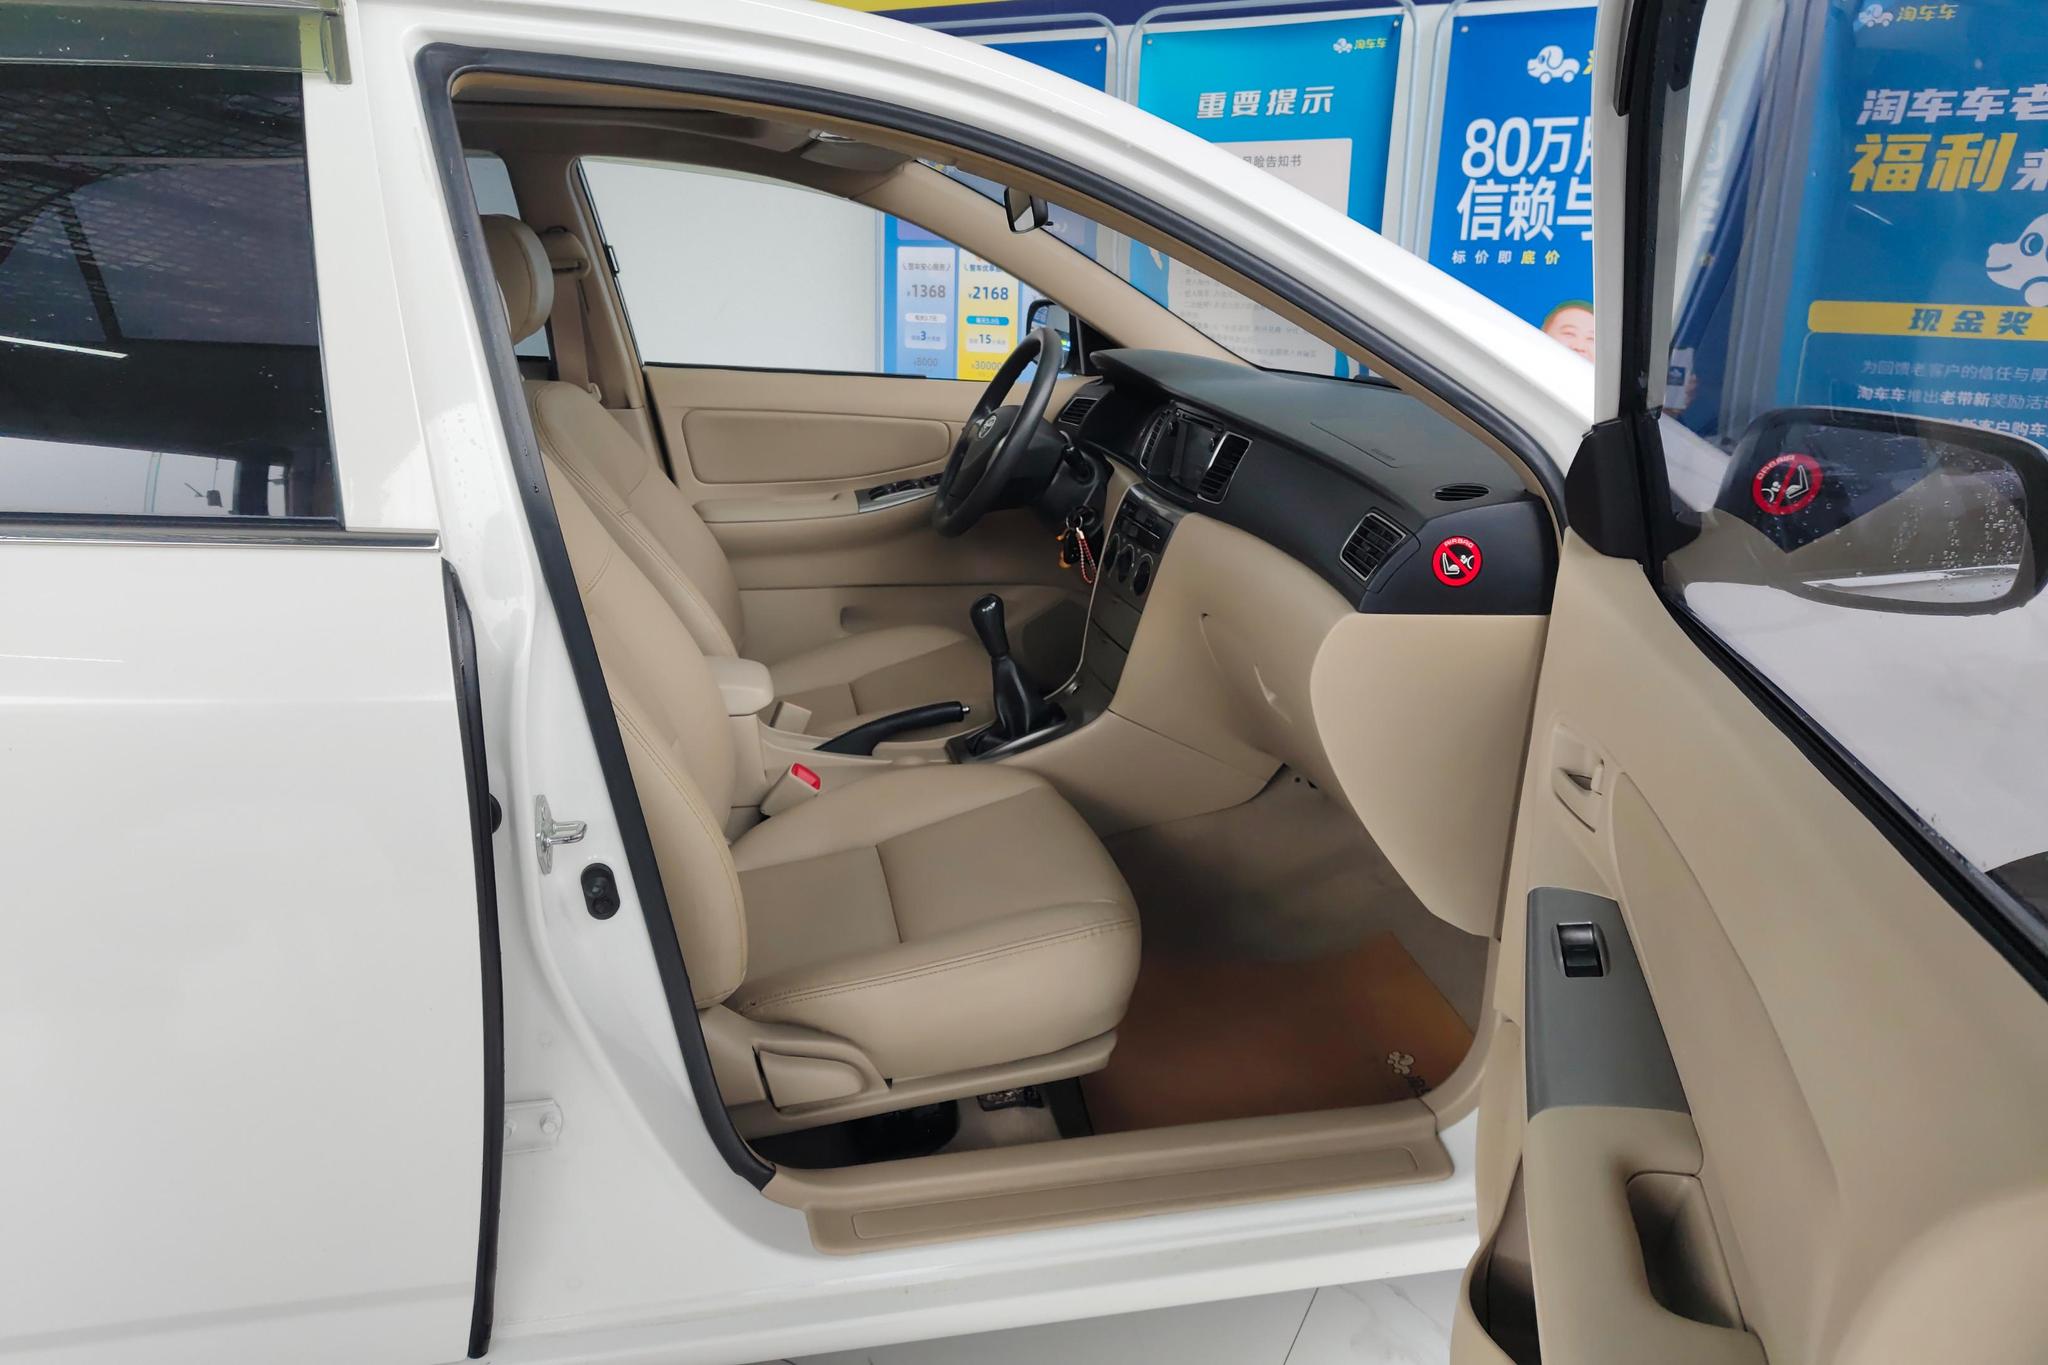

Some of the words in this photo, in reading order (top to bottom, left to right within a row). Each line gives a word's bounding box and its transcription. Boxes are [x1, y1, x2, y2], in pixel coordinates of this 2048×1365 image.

[1196, 86, 1335, 119] 重要提示
[1856, 83, 2048, 125] 淘车车老
[1451, 249, 1560, 265] 标价即底价
[1908, 308, 2033, 336] 现金奖
[1856, 385, 2048, 410] 淘车车推出老带新奖励活
